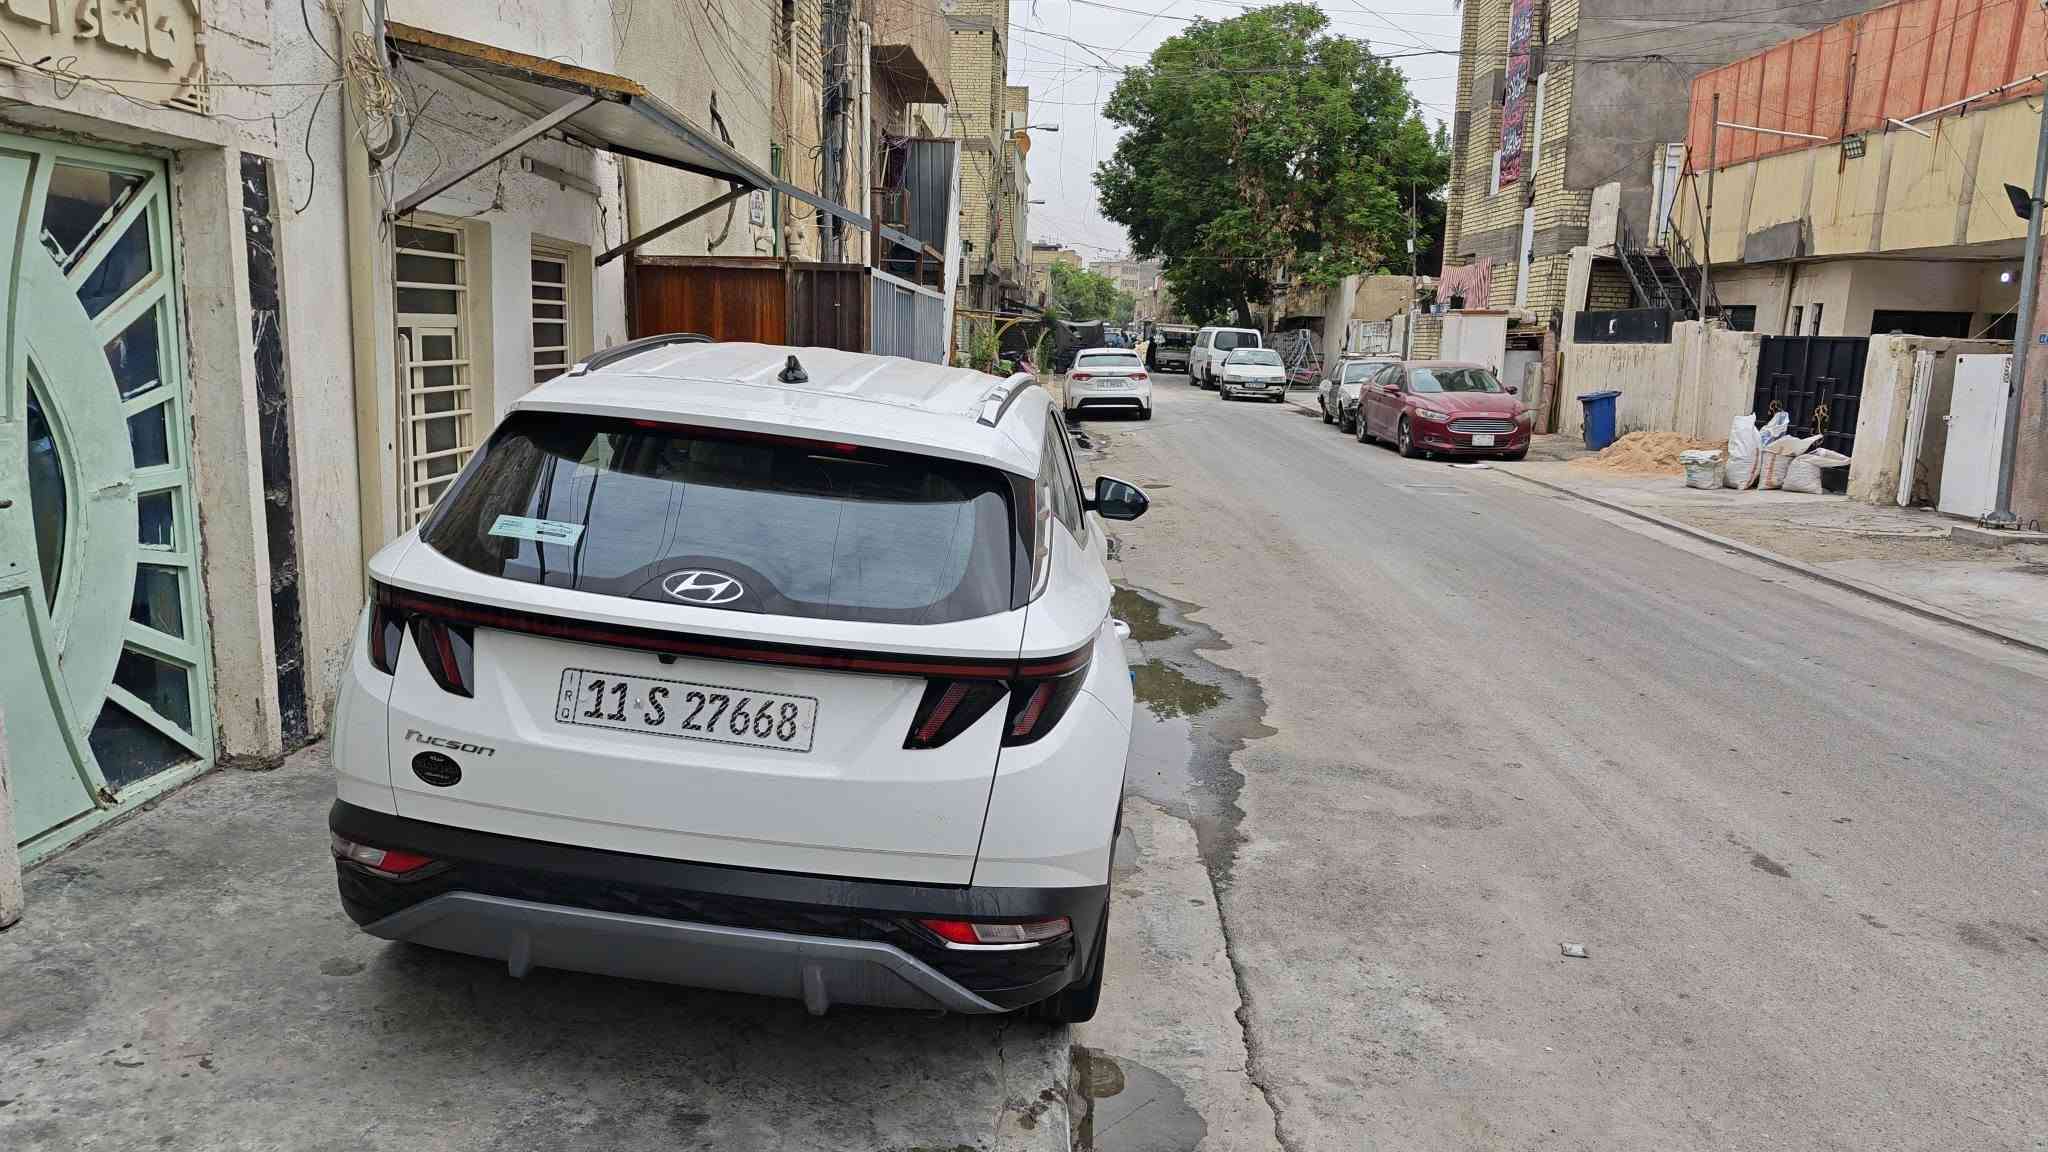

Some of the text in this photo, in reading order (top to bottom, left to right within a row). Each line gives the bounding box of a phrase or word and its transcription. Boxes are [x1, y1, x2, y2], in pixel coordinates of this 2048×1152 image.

[583, 679, 799, 742] 11 S 27668
